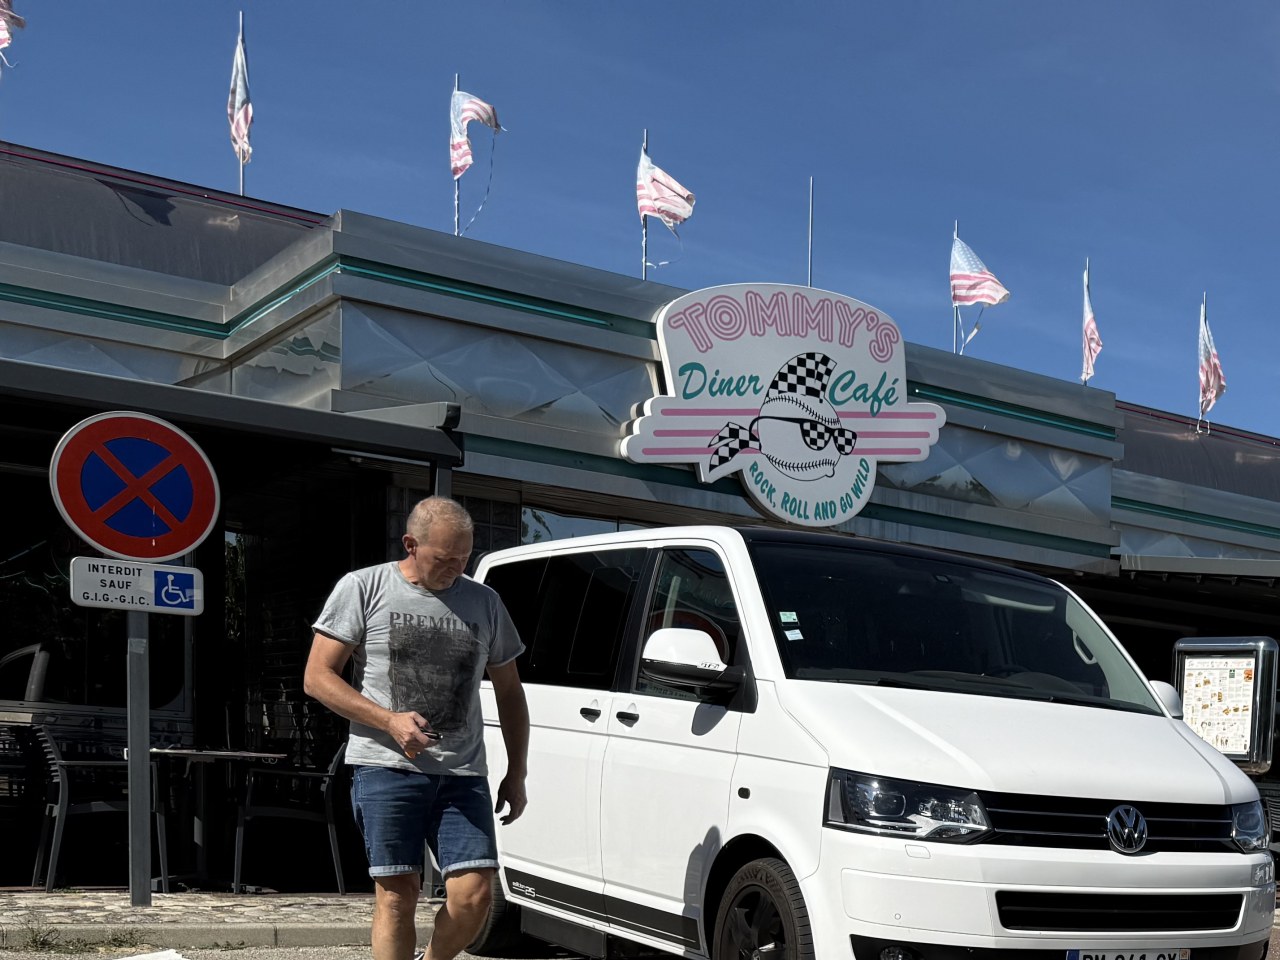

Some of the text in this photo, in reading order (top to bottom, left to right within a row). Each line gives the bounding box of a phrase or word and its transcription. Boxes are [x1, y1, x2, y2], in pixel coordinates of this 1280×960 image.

[668, 290, 899, 363] TOMMY'S
[678, 361, 899, 417] Diner Café
[749, 457, 870, 520] ROCK, ROLL AND GO WILD
[88, 563, 143, 577] INTERDIT
[99, 579, 132, 590] SAUF
